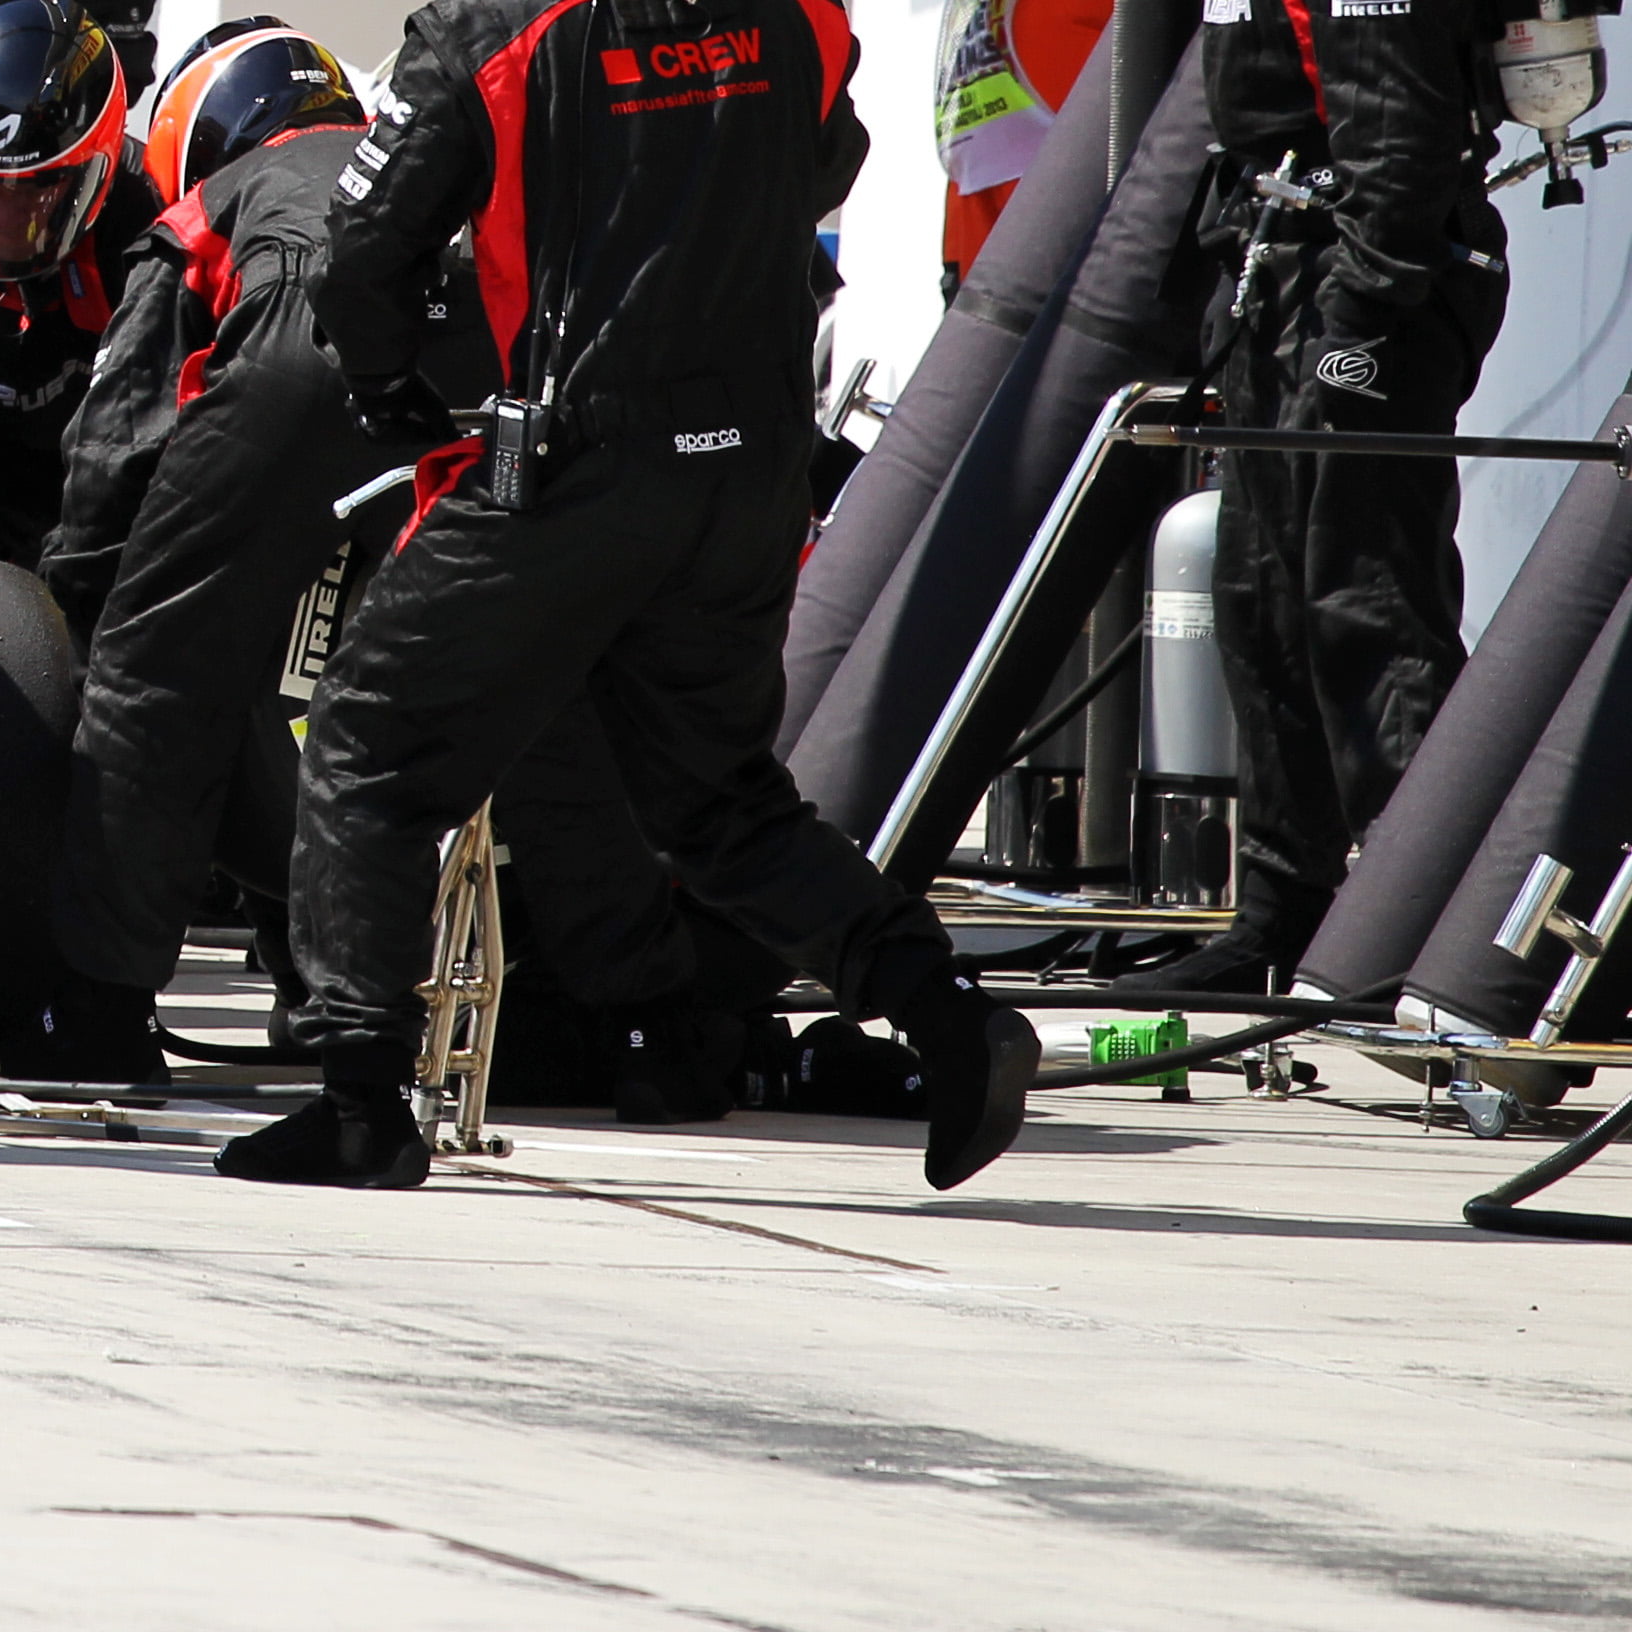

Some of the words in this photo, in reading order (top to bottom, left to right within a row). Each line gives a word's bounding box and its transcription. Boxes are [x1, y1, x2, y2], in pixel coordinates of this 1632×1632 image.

[650, 27, 761, 79] CREW
[305, 69, 329, 81] BEN
[673, 427, 743, 455] sparco
